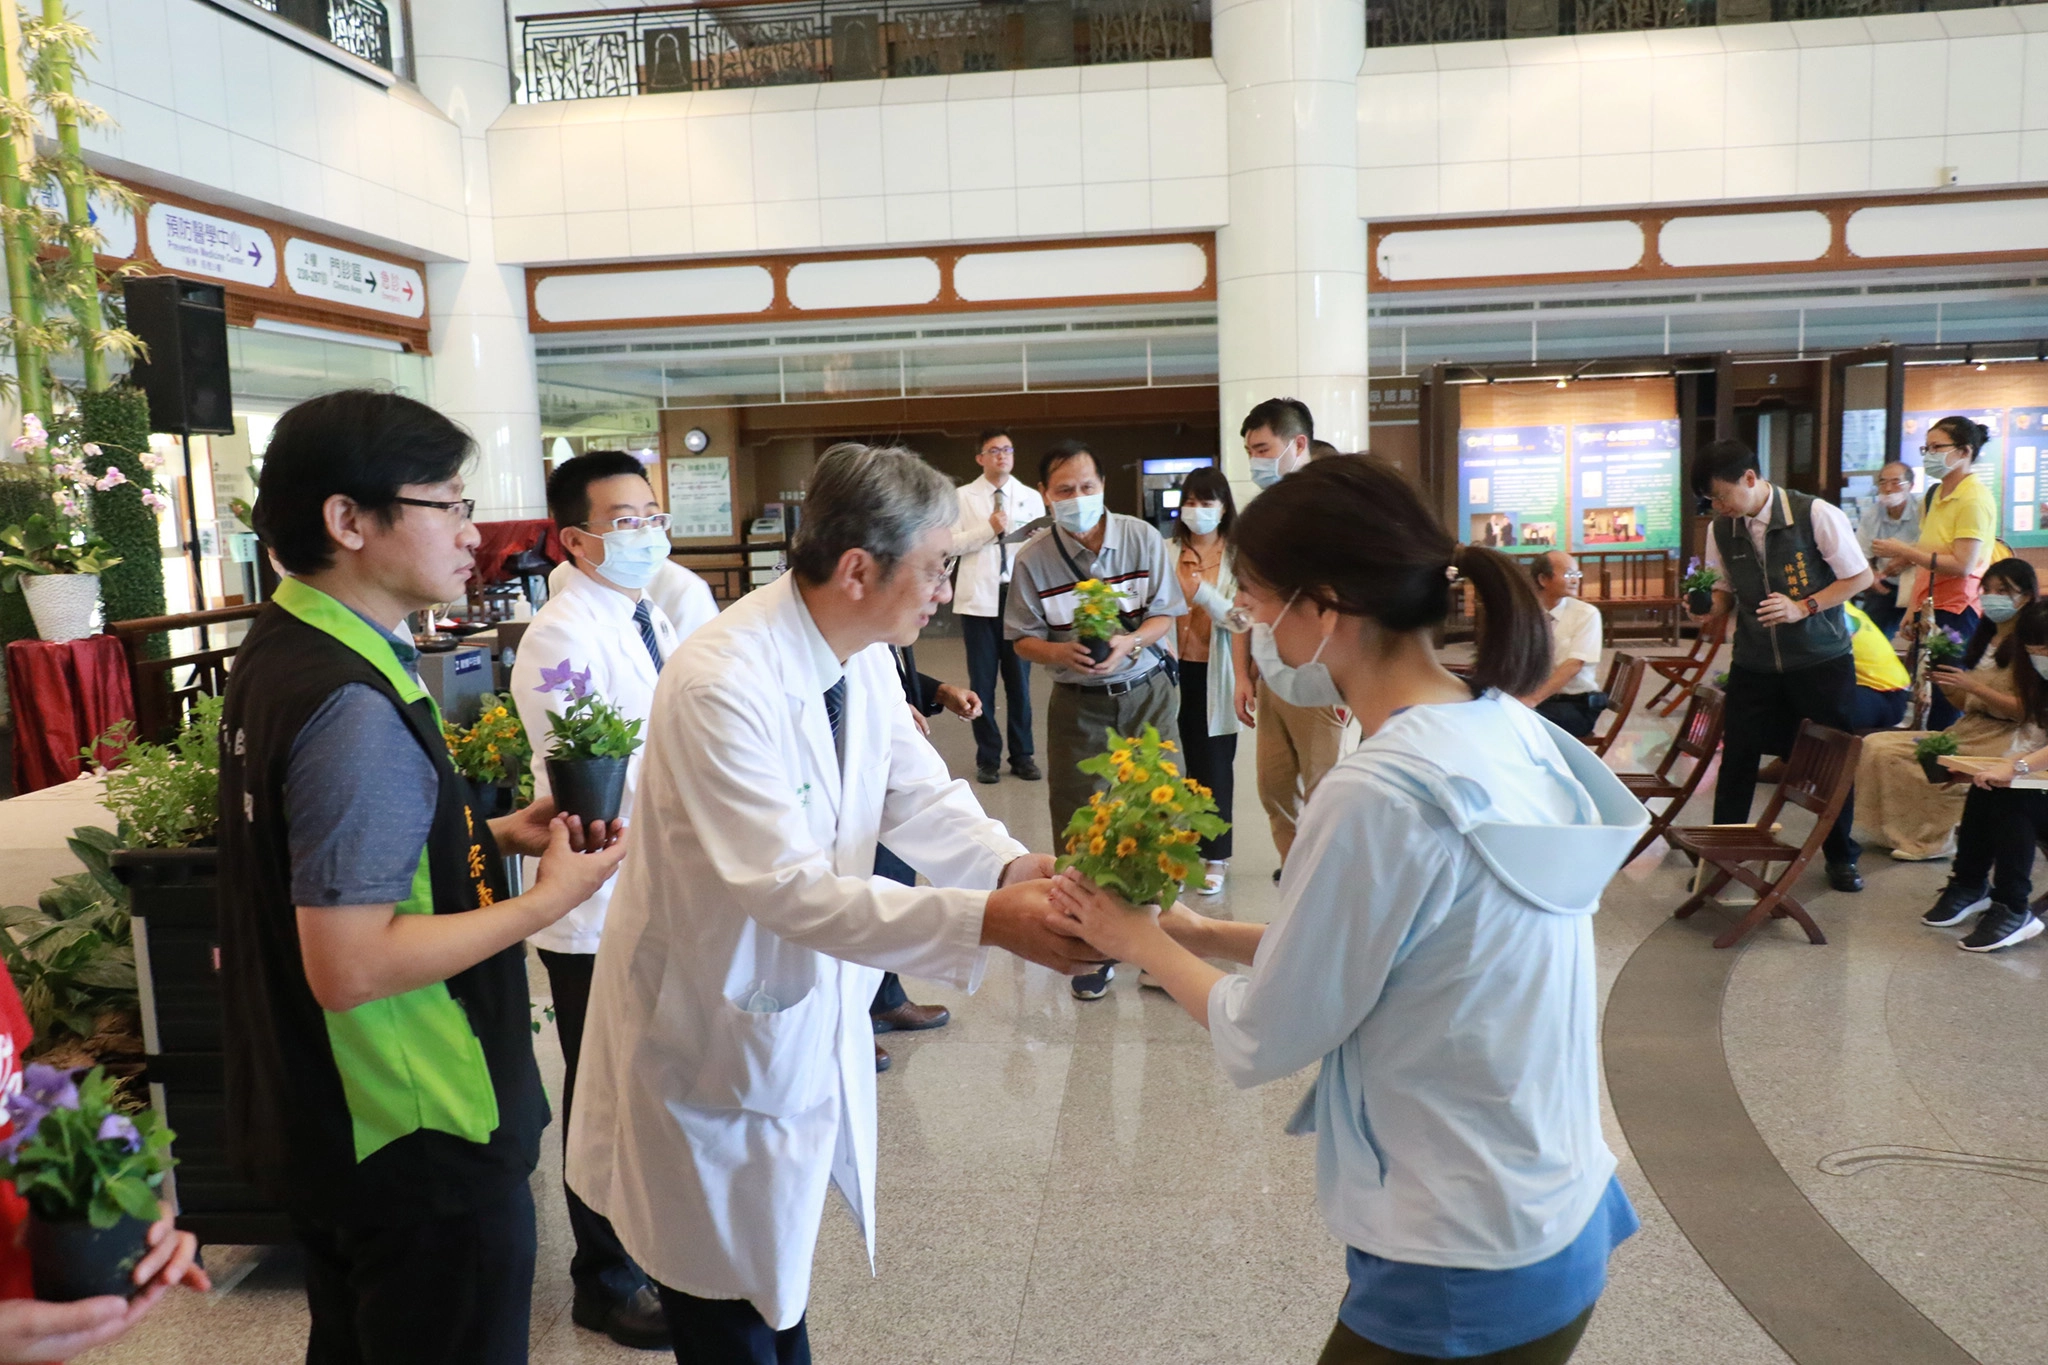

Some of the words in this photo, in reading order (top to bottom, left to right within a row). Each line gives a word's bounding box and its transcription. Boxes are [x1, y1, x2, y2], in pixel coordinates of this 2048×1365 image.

[165, 213, 242, 253] 預防醫學中心
[329, 256, 362, 283] 門診區
[1768, 372, 1778, 385] 2
